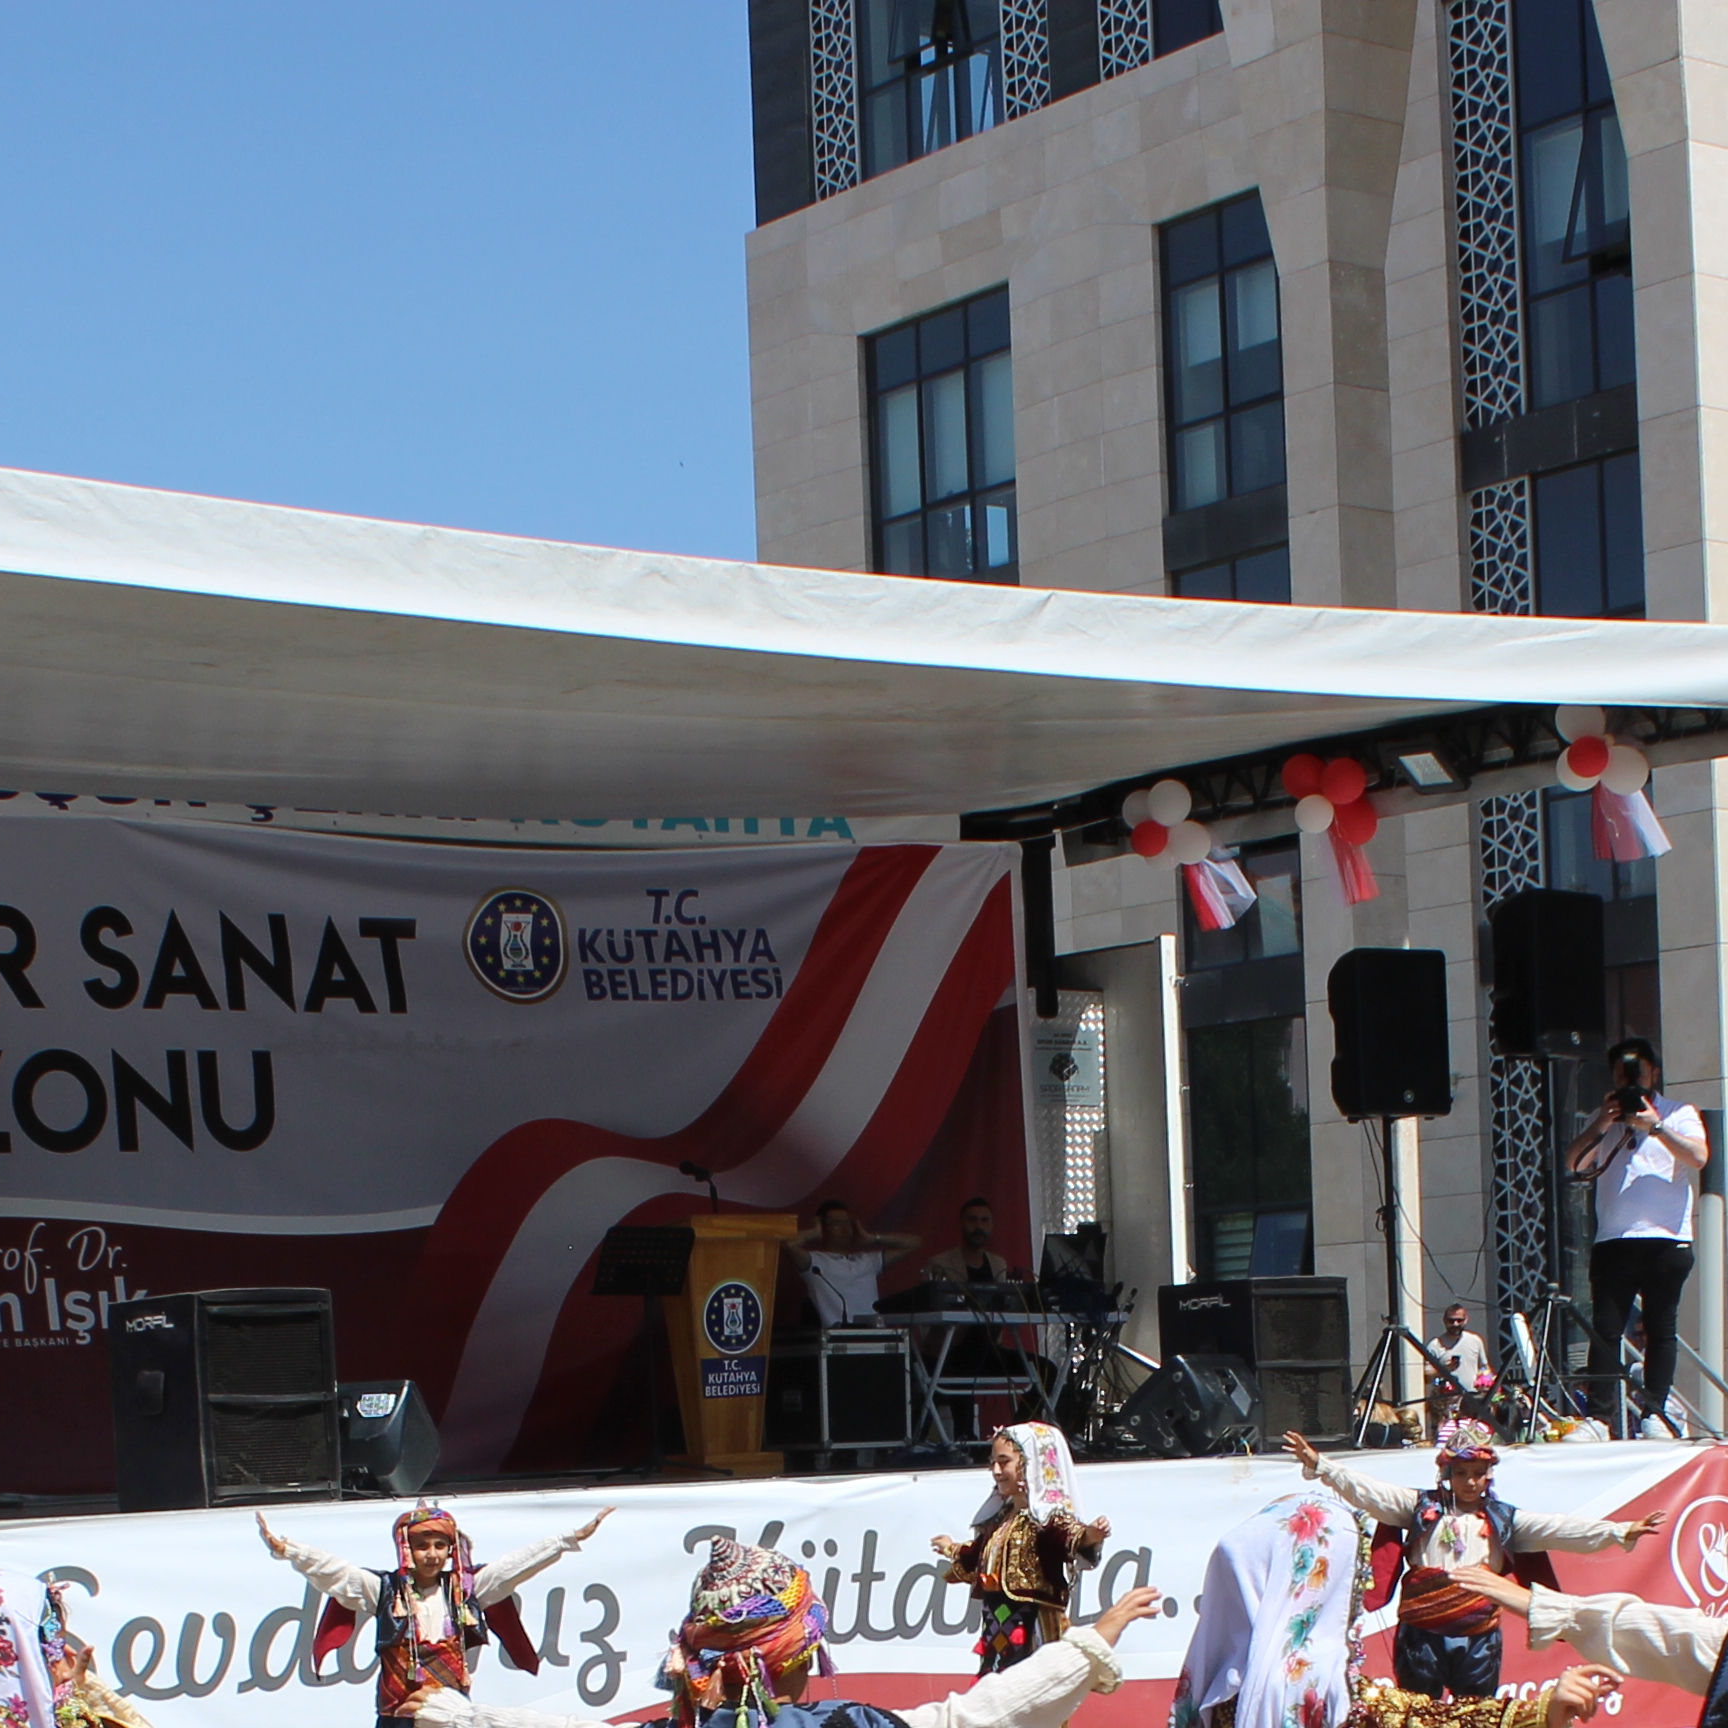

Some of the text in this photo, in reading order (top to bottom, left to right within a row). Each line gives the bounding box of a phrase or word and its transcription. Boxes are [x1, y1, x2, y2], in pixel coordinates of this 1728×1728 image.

[646, 888, 707, 926] T.C.
[79, 905, 417, 1014] SANAT
[578, 928, 778, 964] KÜTAHYA
[582, 966, 783, 1001] BELEDİYESİ
[67, 1226, 128, 1271] Dr.
[15, 1337, 69, 1349] BAŞKANI
[723, 1360, 742, 1371] T.C.
[705, 1383, 761, 1397] BELEDİYESİ
